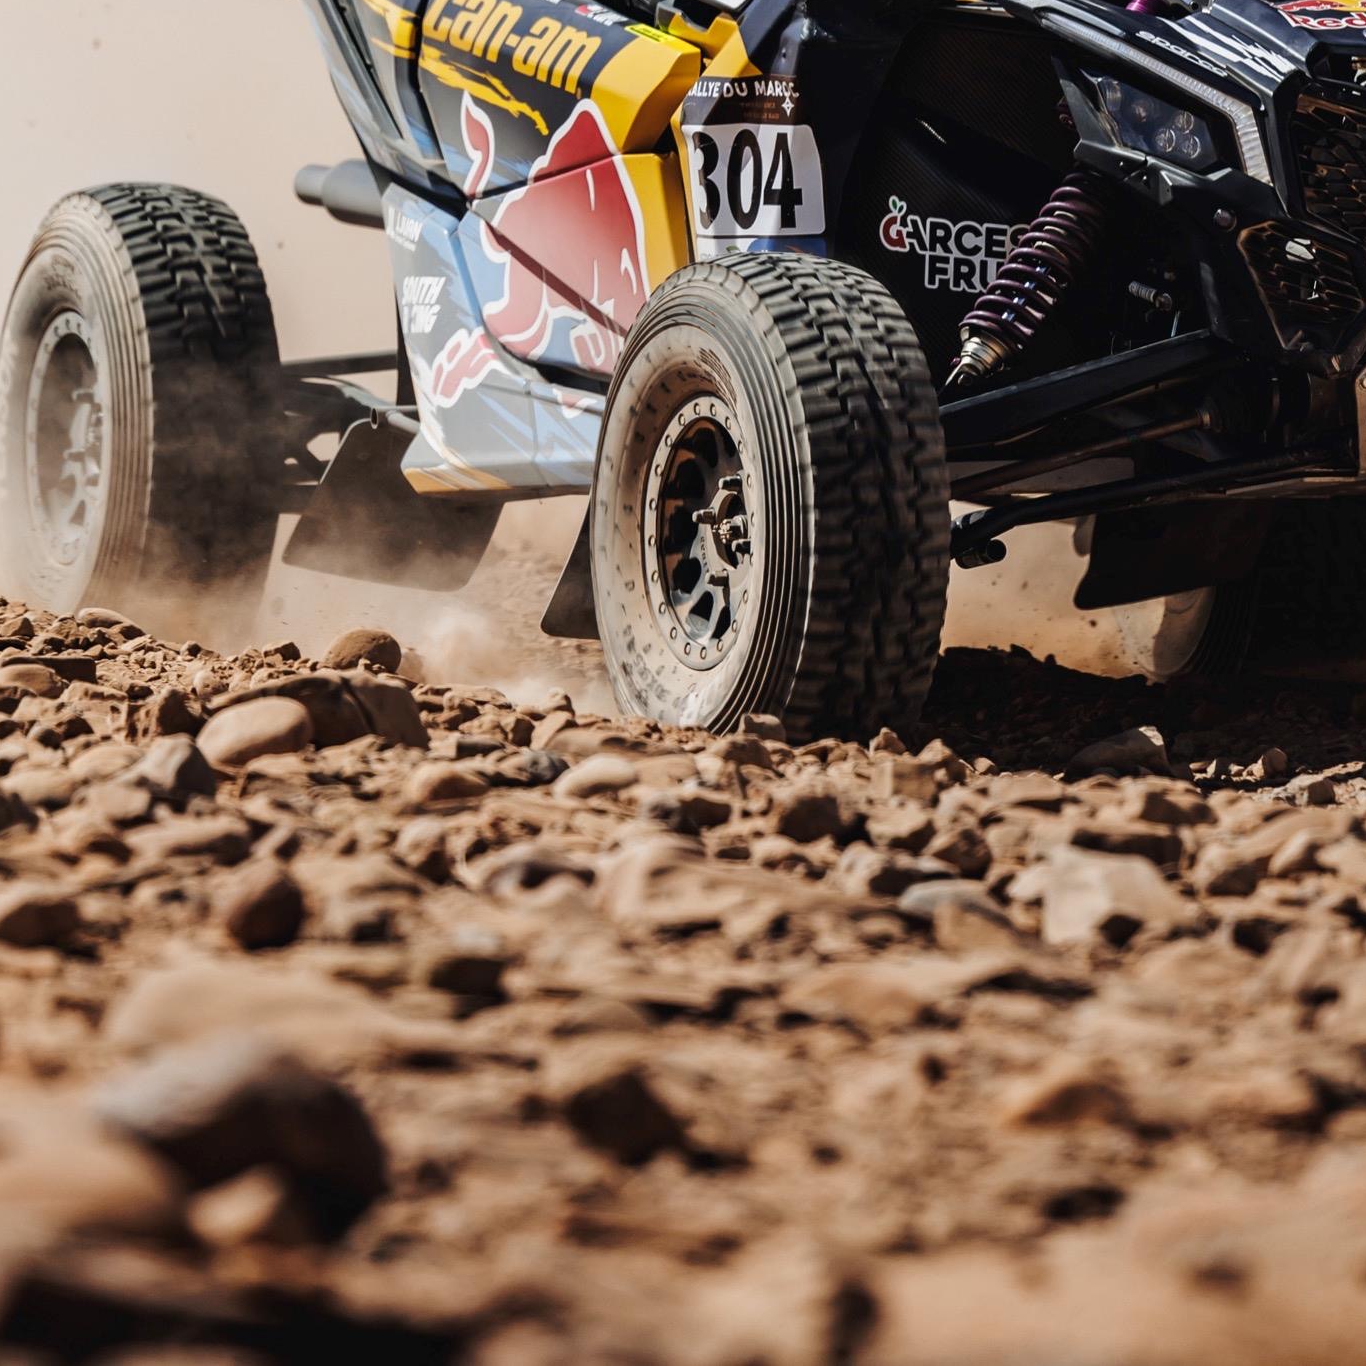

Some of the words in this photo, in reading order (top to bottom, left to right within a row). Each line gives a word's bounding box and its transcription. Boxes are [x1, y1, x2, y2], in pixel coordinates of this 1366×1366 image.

[723, 82, 748, 98] DU
[754, 80, 800, 98] MAROC
[691, 128, 803, 230] 304
